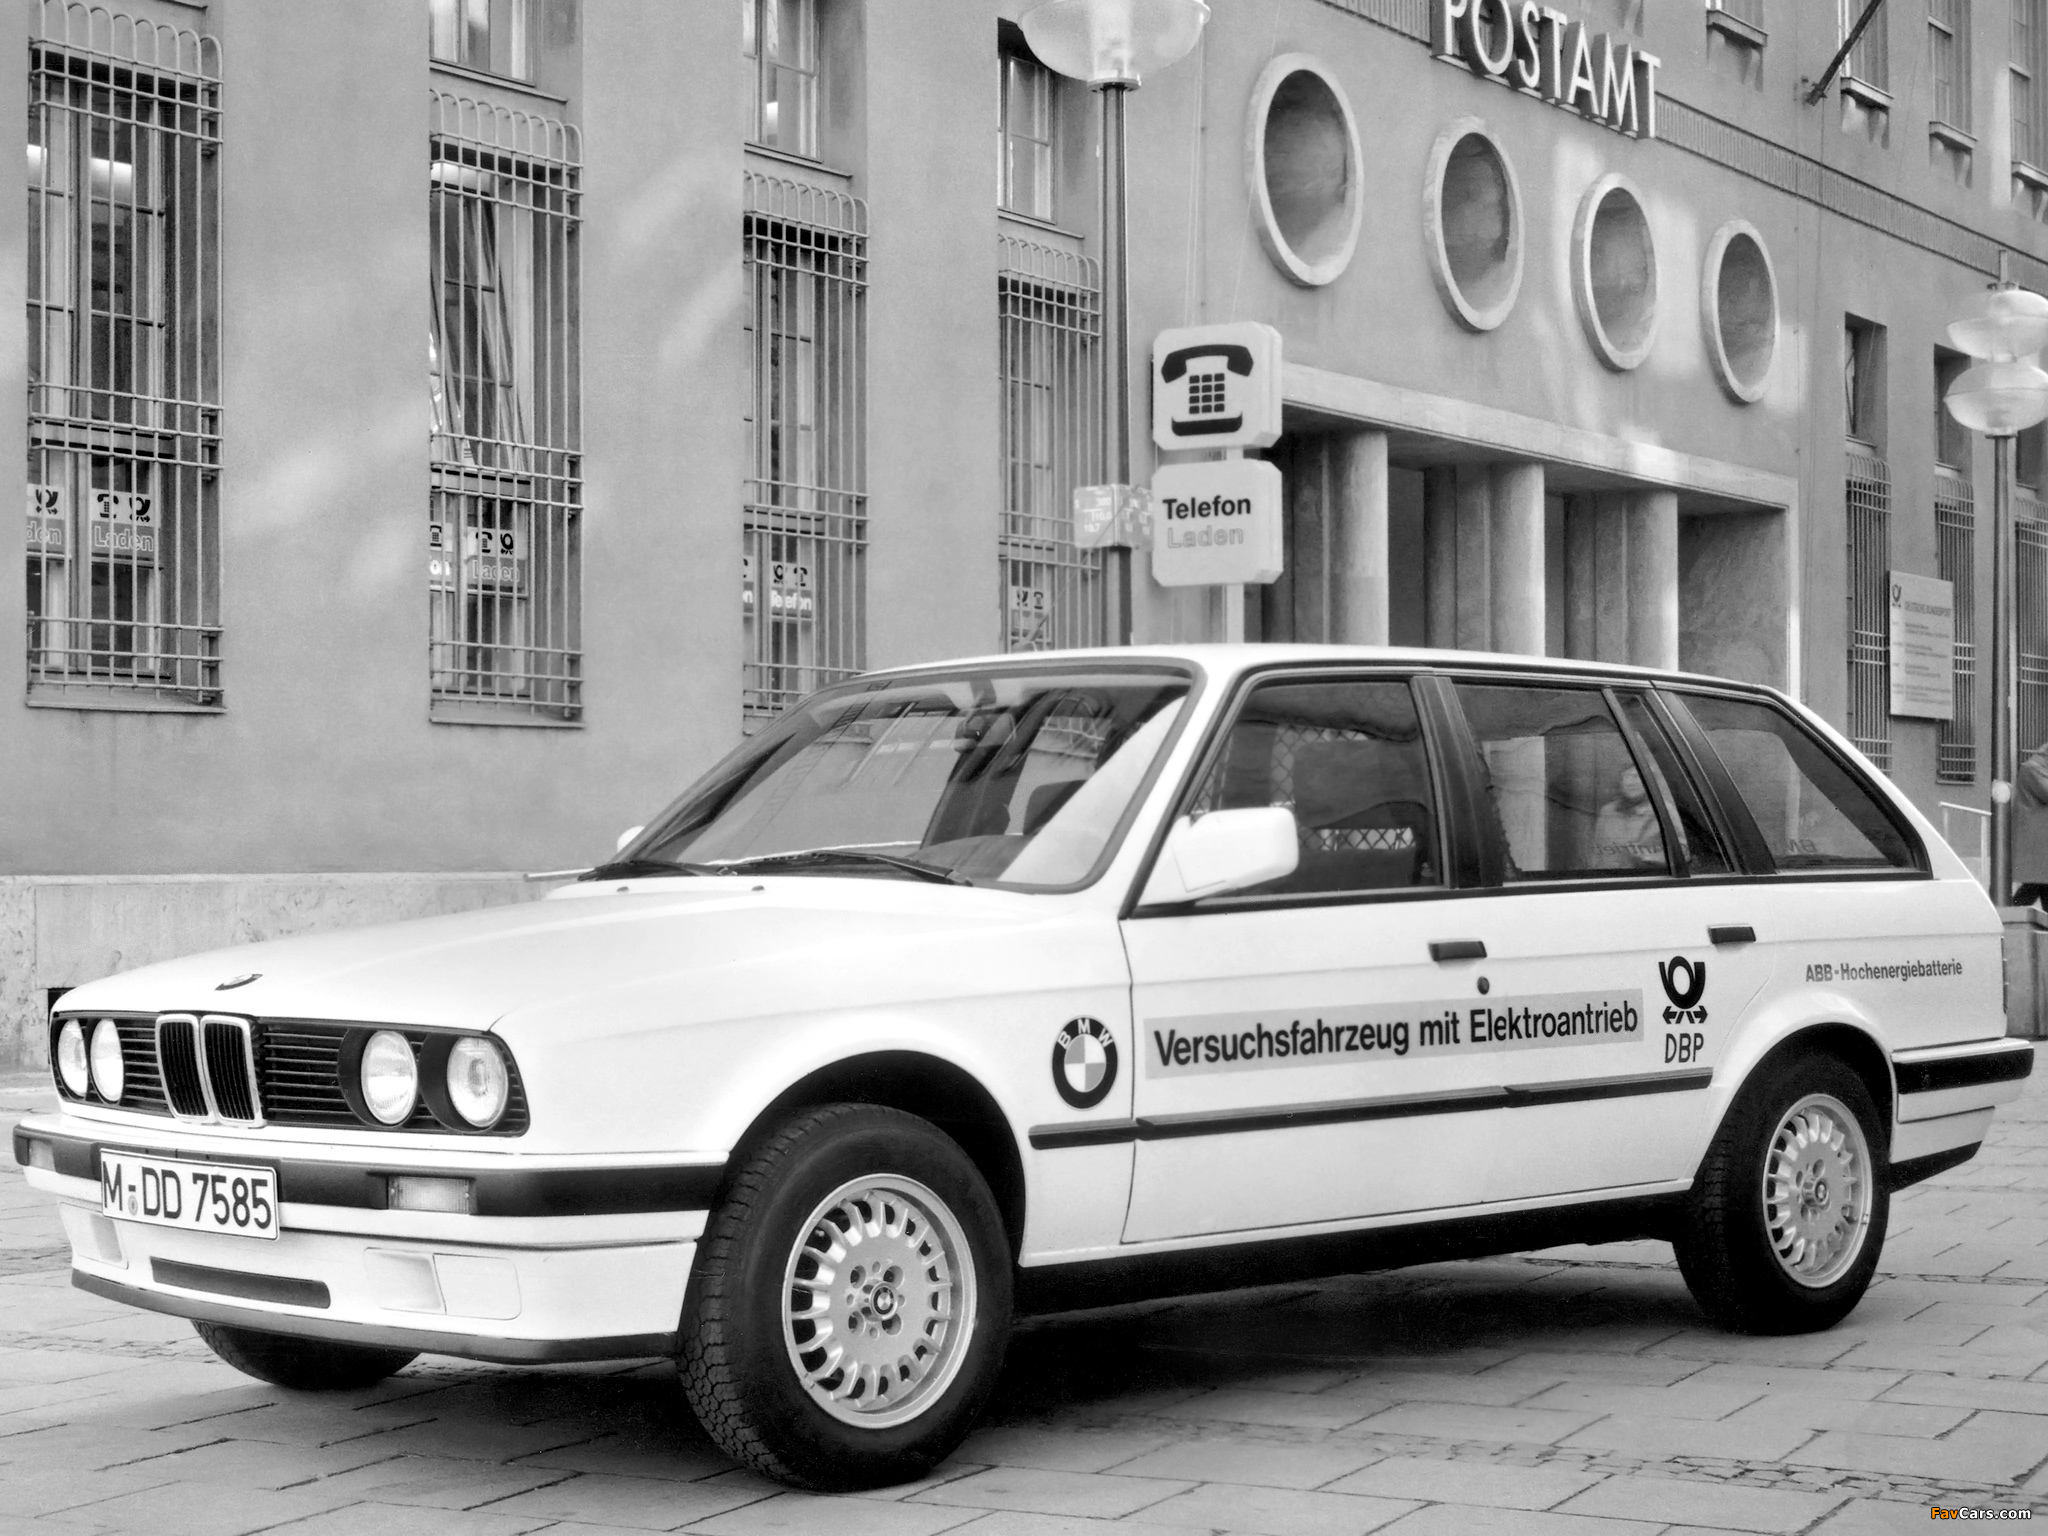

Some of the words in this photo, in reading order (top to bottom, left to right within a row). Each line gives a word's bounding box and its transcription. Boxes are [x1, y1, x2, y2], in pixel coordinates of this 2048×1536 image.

[1440, 0, 1661, 138] POSTAMT
[1163, 495, 1251, 520] Telefon
[94, 525, 155, 552] Laden
[1167, 525, 1244, 549] Laden
[771, 590, 812, 611] Teefon
[1057, 1018, 1113, 1050] BMW
[1154, 1015, 1409, 1066] Versuchsfahrzeug
[1420, 1011, 1460, 1044] mit
[1469, 1001, 1638, 1043] Elektroantrieb
[1664, 1032, 1705, 1064] DBP
[192, 1172, 272, 1230] 7585
